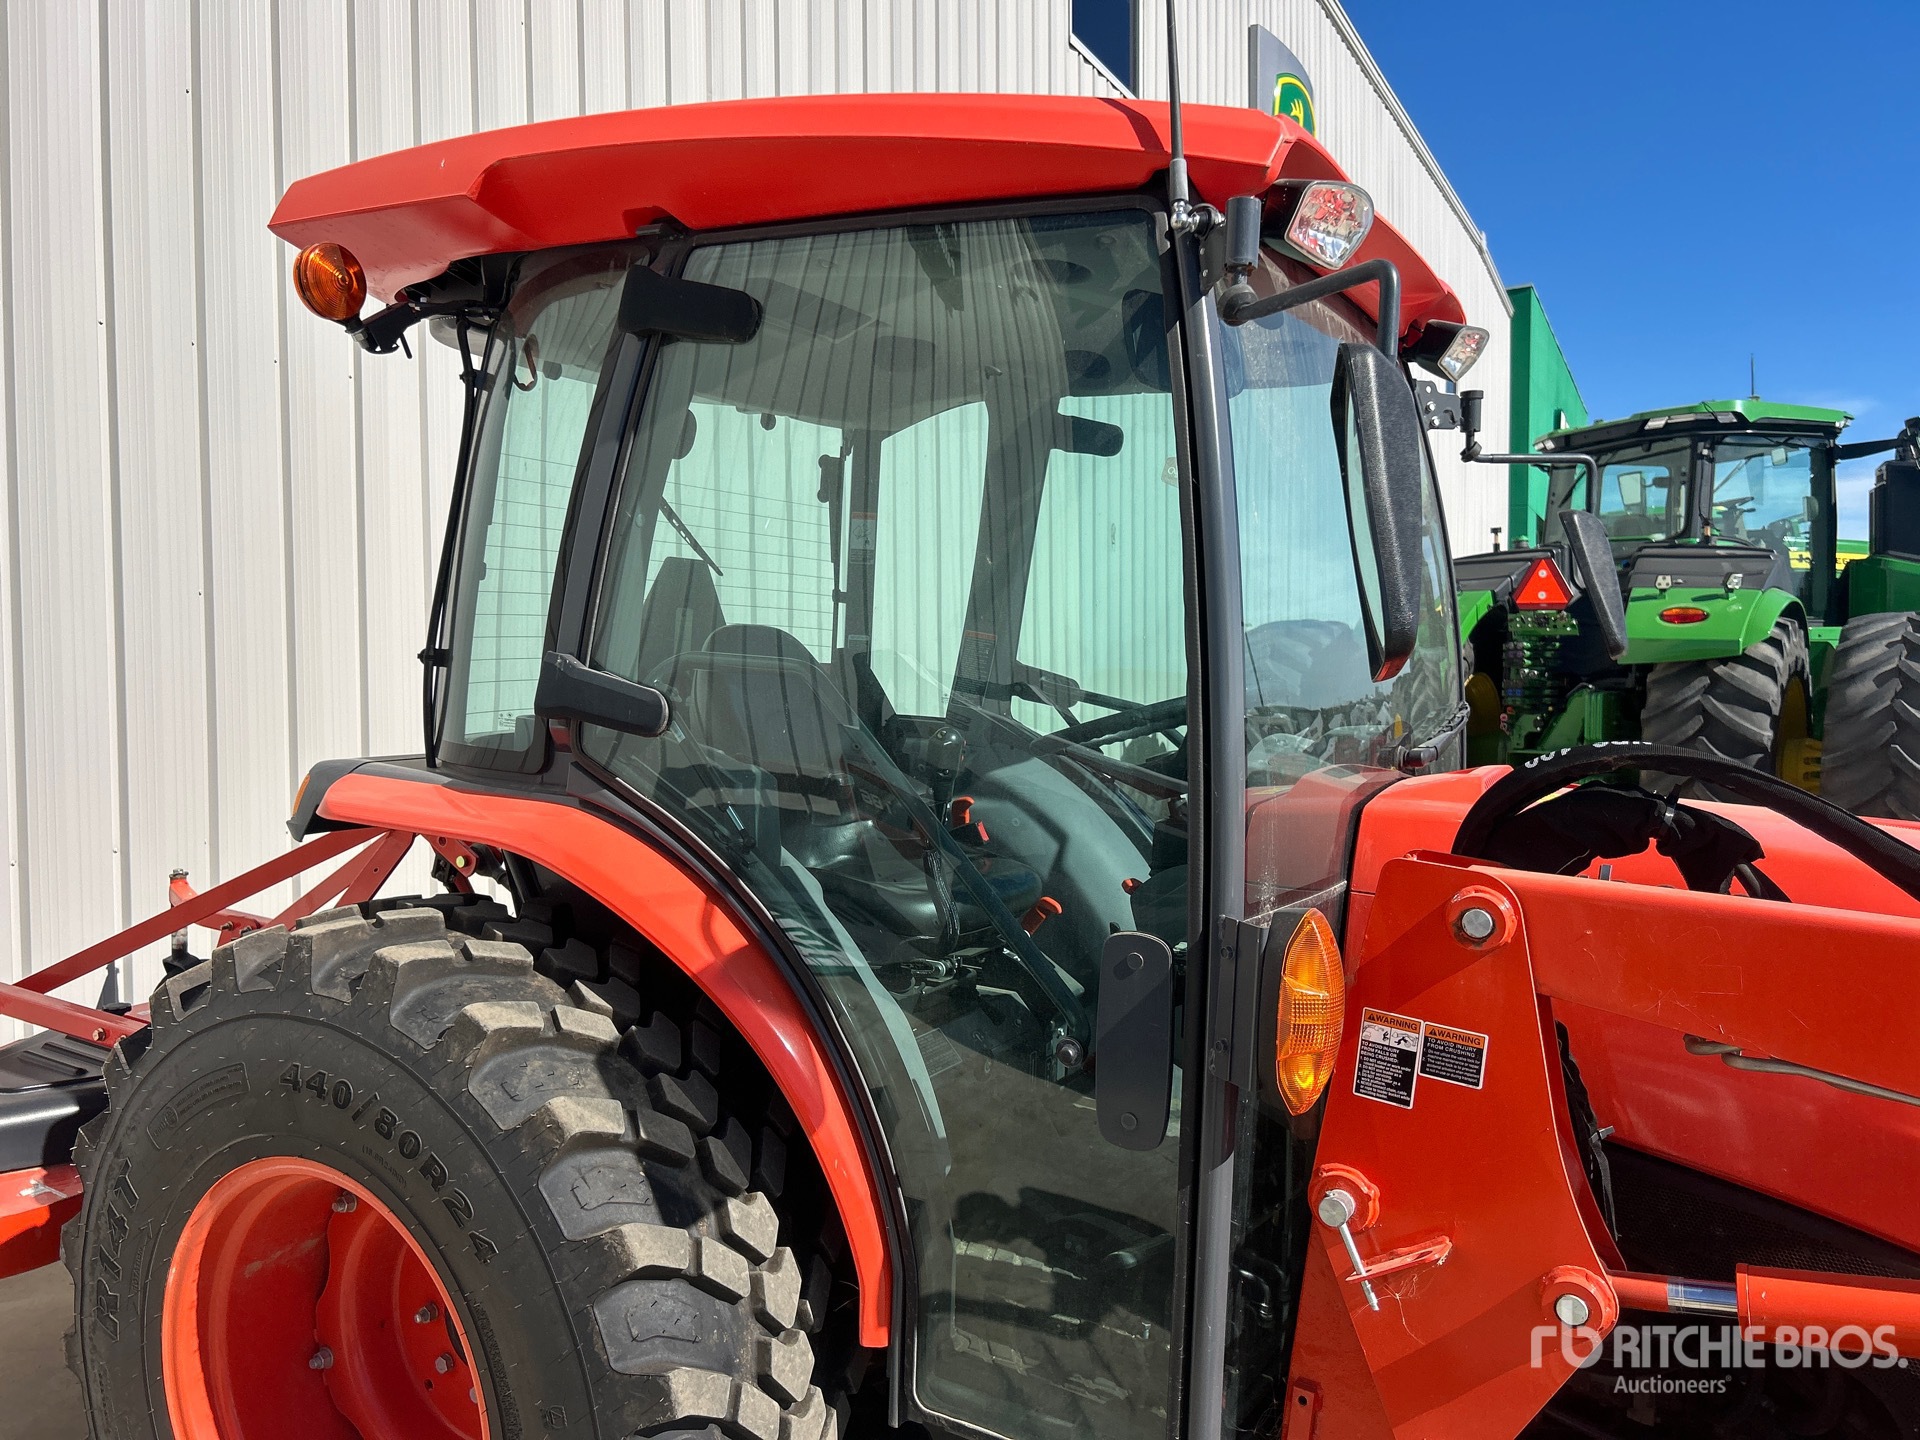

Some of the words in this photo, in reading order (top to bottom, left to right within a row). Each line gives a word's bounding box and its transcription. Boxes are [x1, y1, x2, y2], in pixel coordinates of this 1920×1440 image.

[1376, 1015, 1418, 1031] WARNING
[1437, 1029, 1481, 1045] WARNING
[1456, 1044, 1476, 1052] INJURY
[279, 1062, 499, 1264] 440/80R24
